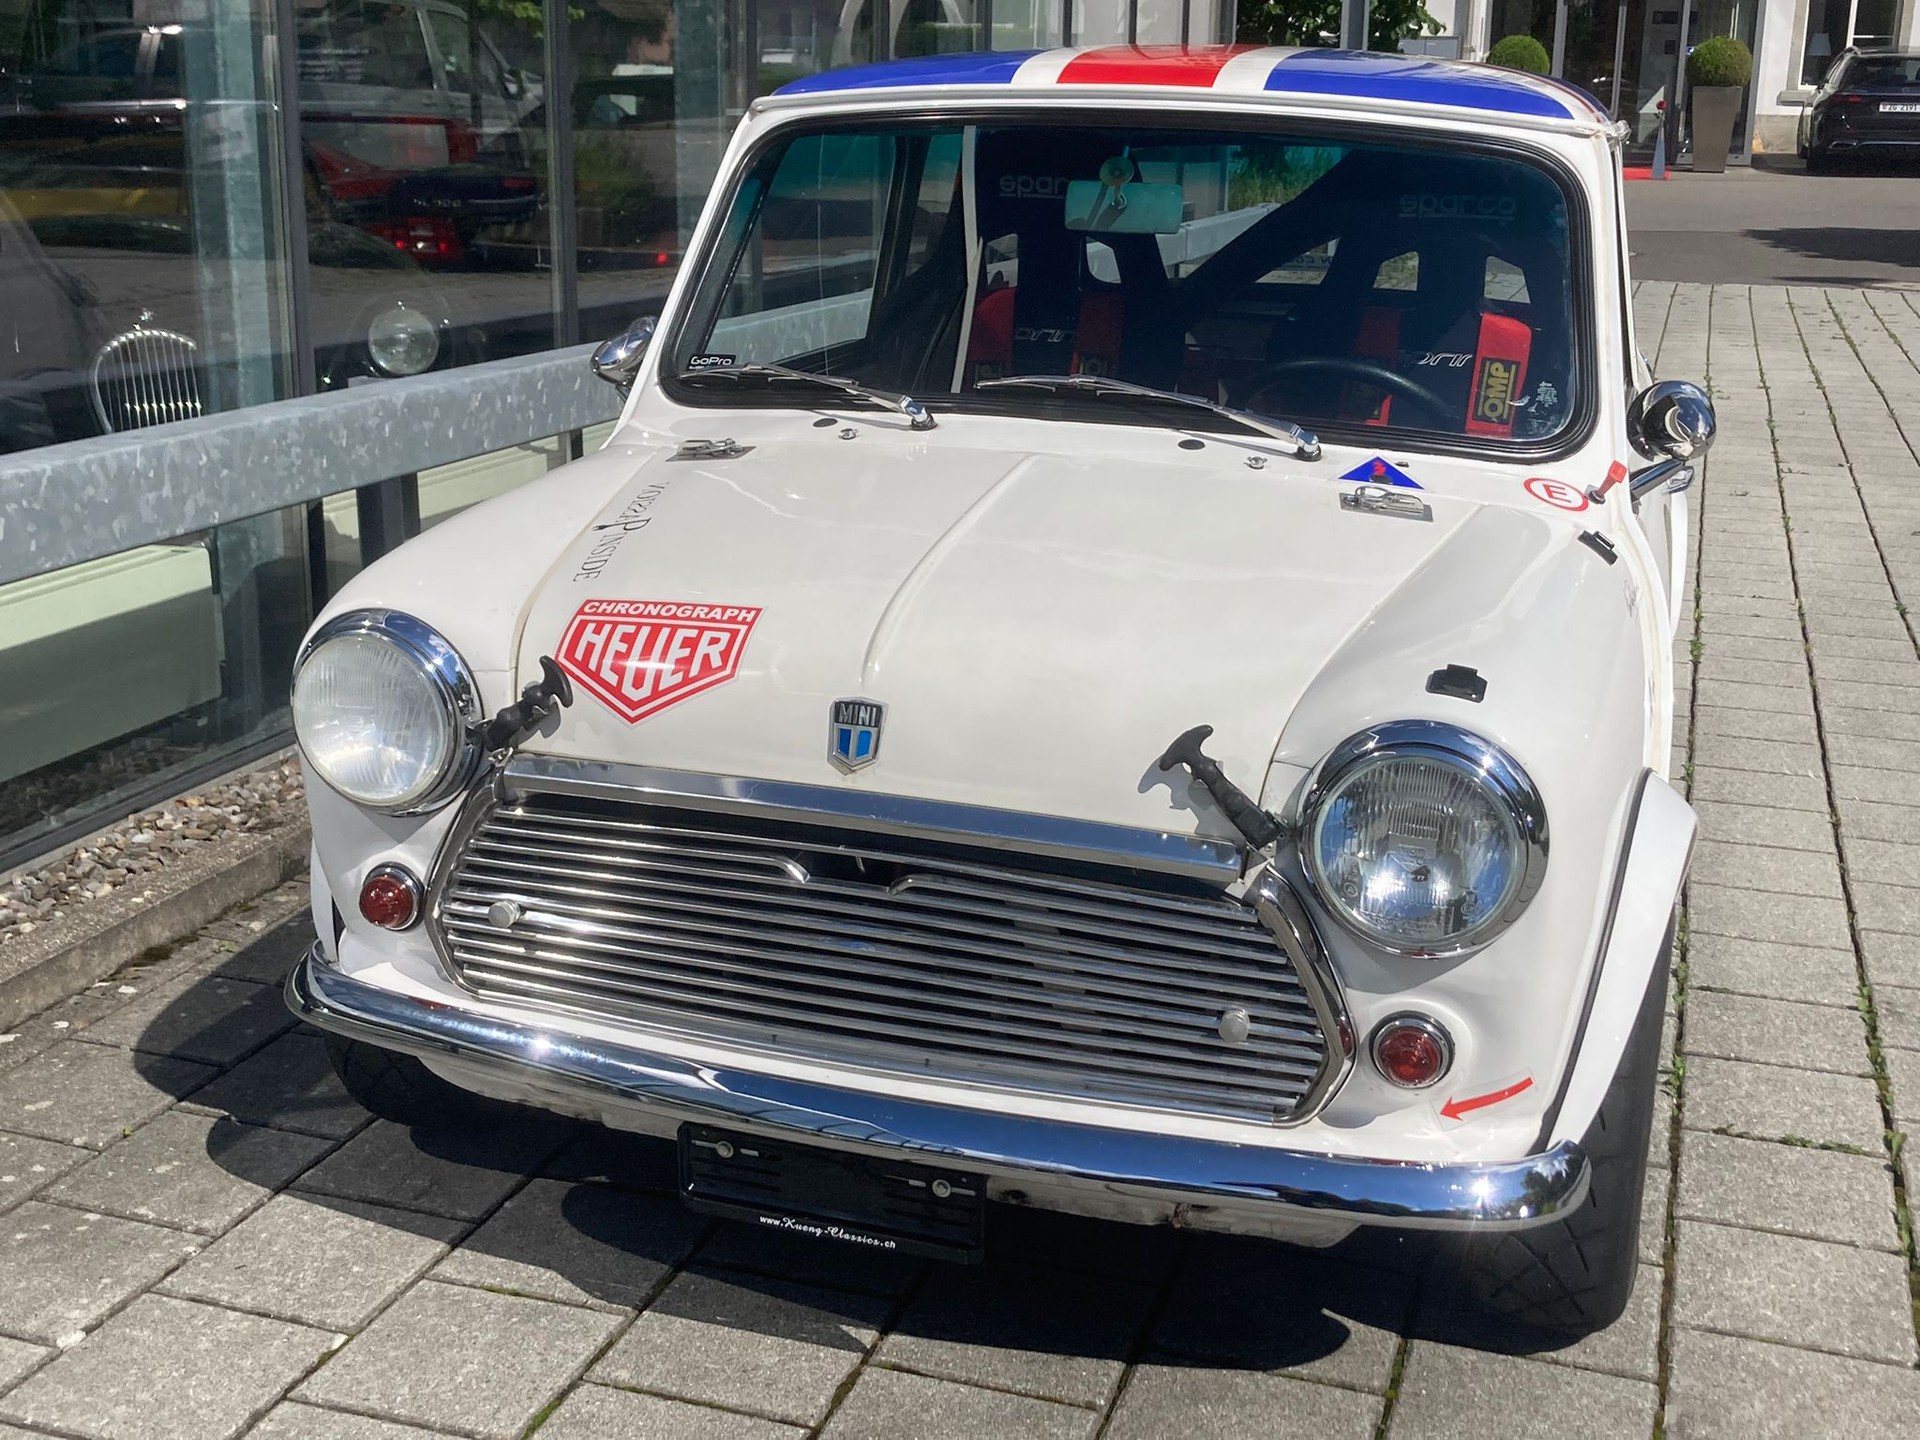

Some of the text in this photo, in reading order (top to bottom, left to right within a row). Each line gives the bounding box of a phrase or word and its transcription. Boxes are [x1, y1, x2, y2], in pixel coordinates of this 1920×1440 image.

[999, 175, 1066, 199] spar
[690, 356, 732, 366] GoPro
[1483, 361, 1510, 418] OMP
[573, 531, 628, 582] INSIDE
[583, 601, 757, 623] CHRONOGRAPH
[574, 622, 731, 702] HEUER
[839, 702, 877, 727] MINI
